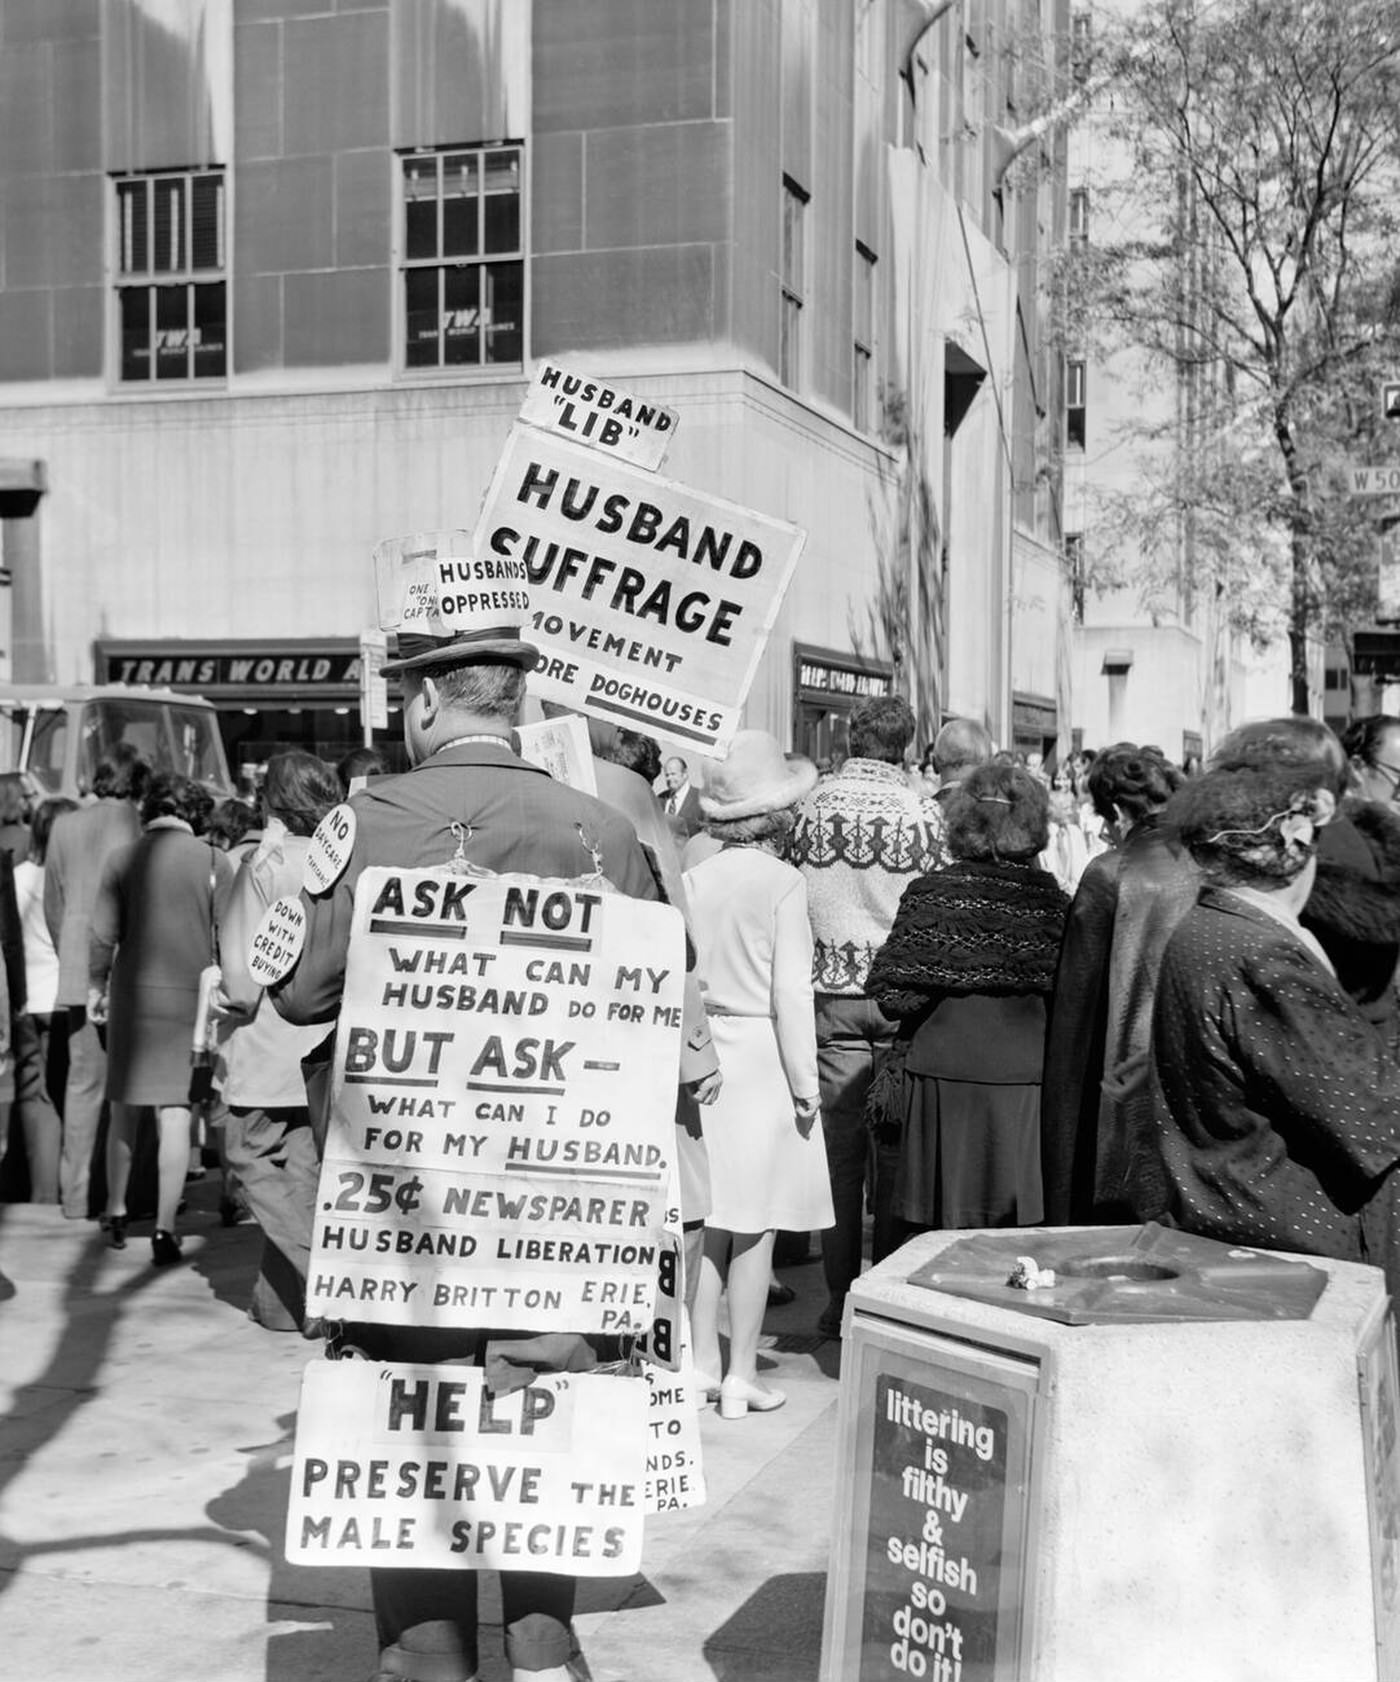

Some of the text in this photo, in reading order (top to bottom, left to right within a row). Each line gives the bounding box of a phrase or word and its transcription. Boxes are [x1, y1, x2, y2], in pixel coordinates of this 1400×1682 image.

[540, 366, 672, 432] HUSBAND
[553, 394, 640, 447] "LIB"
[1354, 471, 1369, 490] W
[516, 461, 763, 580] HUSBAND
[439, 560, 526, 583] HUSBANDS
[441, 591, 530, 615] OPPRESSED
[121, 660, 215, 681] TRANS
[229, 658, 332, 681] WORLD
[589, 673, 723, 732] DOGHOUSES
[329, 811, 349, 840] NO
[274, 901, 303, 929] DOWN
[370, 876, 602, 934] ASK NOT
[253, 933, 294, 966] CREDIT
[268, 919, 296, 944] WITH
[251, 955, 283, 980] BUYING
[388, 946, 670, 994] WHAT CAN MY
[381, 981, 683, 1029] HUSBAND DO FOR ME
[344, 1026, 456, 1075] BUT
[469, 1034, 577, 1082] ASK
[367, 1094, 612, 1128] WHAT CAN I DO
[363, 1127, 668, 1170] FOR MY HUSBAND.
[321, 1225, 656, 1266] HUSBAND LIBERATION
[314, 1274, 419, 1302] HARRY
[433, 1284, 562, 1311] BRITTON
[601, 1310, 644, 1332] PA.
[380, 1368, 570, 1437] "HELP"
[649, 1419, 682, 1440] TO
[886, 1388, 995, 1462] littering
[924, 1438, 949, 1475] is
[302, 1457, 637, 1508] PRESERVE THE
[901, 1465, 969, 1523] filthy
[299, 1515, 628, 1559] MALE SPECIES
[921, 1509, 944, 1547] &
[886, 1536, 977, 1596] selfish
[910, 1581, 947, 1617] so
[892, 1604, 964, 1662] don't
[889, 1638, 928, 1678] do
